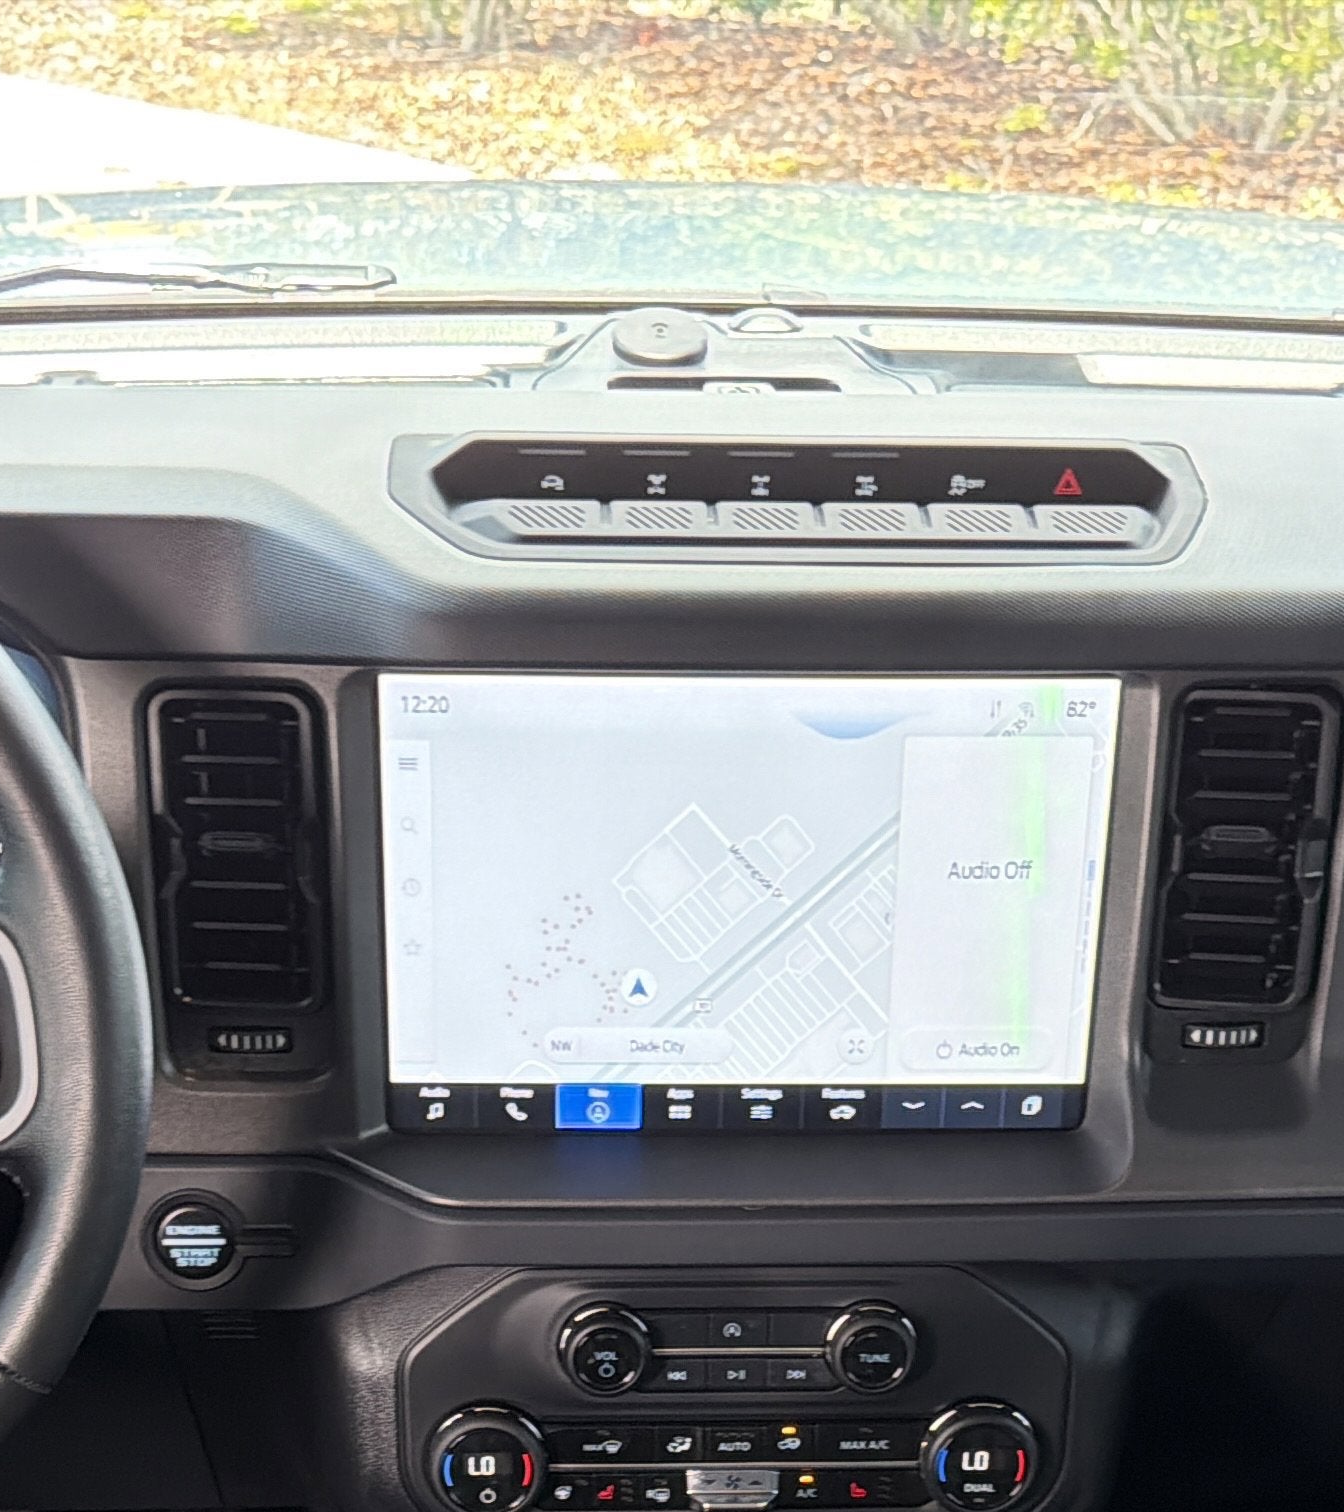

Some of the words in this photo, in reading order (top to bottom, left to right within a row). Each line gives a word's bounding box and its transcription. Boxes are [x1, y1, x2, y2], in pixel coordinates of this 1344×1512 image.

[400, 695, 449, 714] 12:20
[948, 861, 1000, 880] Audio
[1005, 860, 1032, 880] Off
[662, 1039, 685, 1054] City
[958, 1043, 998, 1057] Audio
[1001, 1043, 1020, 1057] On
[594, 1350, 618, 1362] VOL
[859, 1353, 890, 1364] TUNE
[718, 1441, 751, 1452] AUTO
[839, 1440, 866, 1451] MAX
[868, 1440, 890, 1451] A/C
[795, 1488, 817, 1499] A/C
[963, 1483, 995, 1493] DUAL
